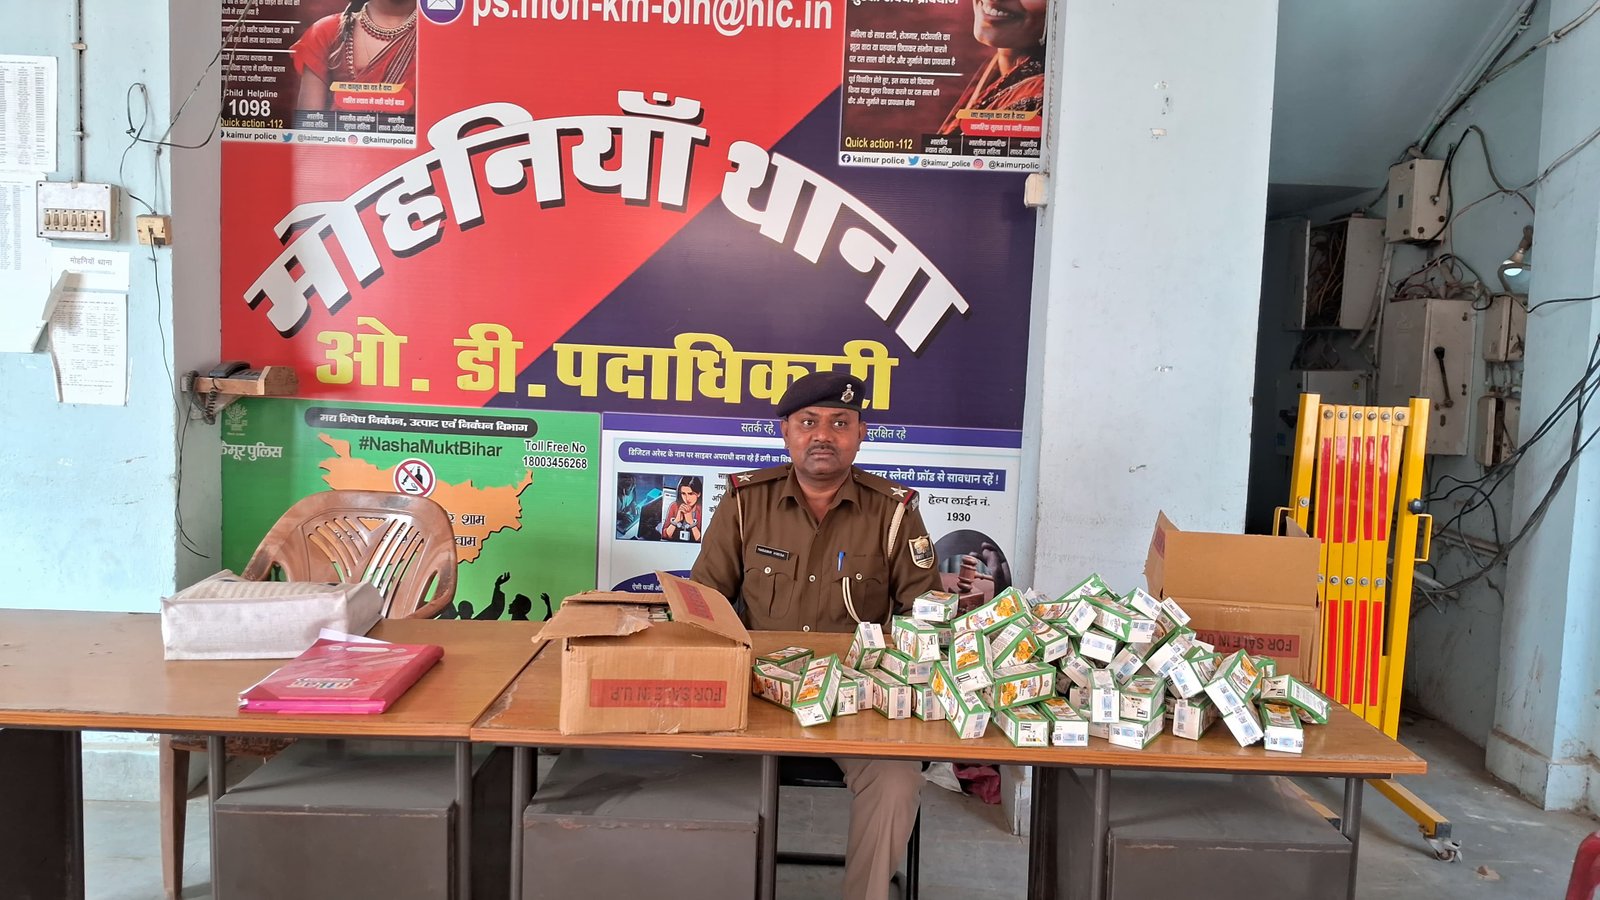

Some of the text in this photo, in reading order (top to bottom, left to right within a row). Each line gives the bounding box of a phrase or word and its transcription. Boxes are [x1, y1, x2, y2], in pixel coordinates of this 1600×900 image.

[247, 90, 278, 99] Helpline
[229, 99, 270, 116] 1098
[242, 118, 265, 128] action
[267, 119, 283, 128] -112
[227, 130, 252, 138] kaimur
[254, 131, 277, 140] police
[362, 136, 414, 146] @kaimurpolice
[845, 136, 913, 150] Quick action -112
[881, 156, 905, 165] police
[921, 158, 970, 169] @kaimur_police
[989, 160, 1040, 170] @kaimurpolic
[721, 140, 970, 354] थाना
[316, 316, 430, 392] ओ.
[410, 418, 438, 428] उत्पाद
[458, 418, 493, 431] निबंधन
[496, 420, 528, 432] विभाग
[741, 422, 776, 436] सतर्क रहे,
[867, 427, 906, 441] सुरक्षित रहे
[247, 441, 283, 461] पुलिस
[359, 436, 503, 457] #NashaMuktBihar
[525, 440, 586, 453] Toll Free No
[522, 456, 588, 470] 18003456268
[917, 469, 935, 482] फ्रॉड
[937, 470, 945, 482] से
[947, 475, 980, 484] सावधान
[982, 472, 994, 485] रहें
[928, 494, 948, 505] हेल्प
[951, 496, 977, 506] लाईन
[461, 515, 485, 526] शाम
[947, 512, 971, 522] 1930
[1218, 636, 1229, 648] IN
[1233, 638, 1265, 651] SALE
[1268, 641, 1293, 652] FOR
[637, 686, 651, 700] IN
[655, 686, 689, 701] SALE
[696, 686, 722, 701] FOR
